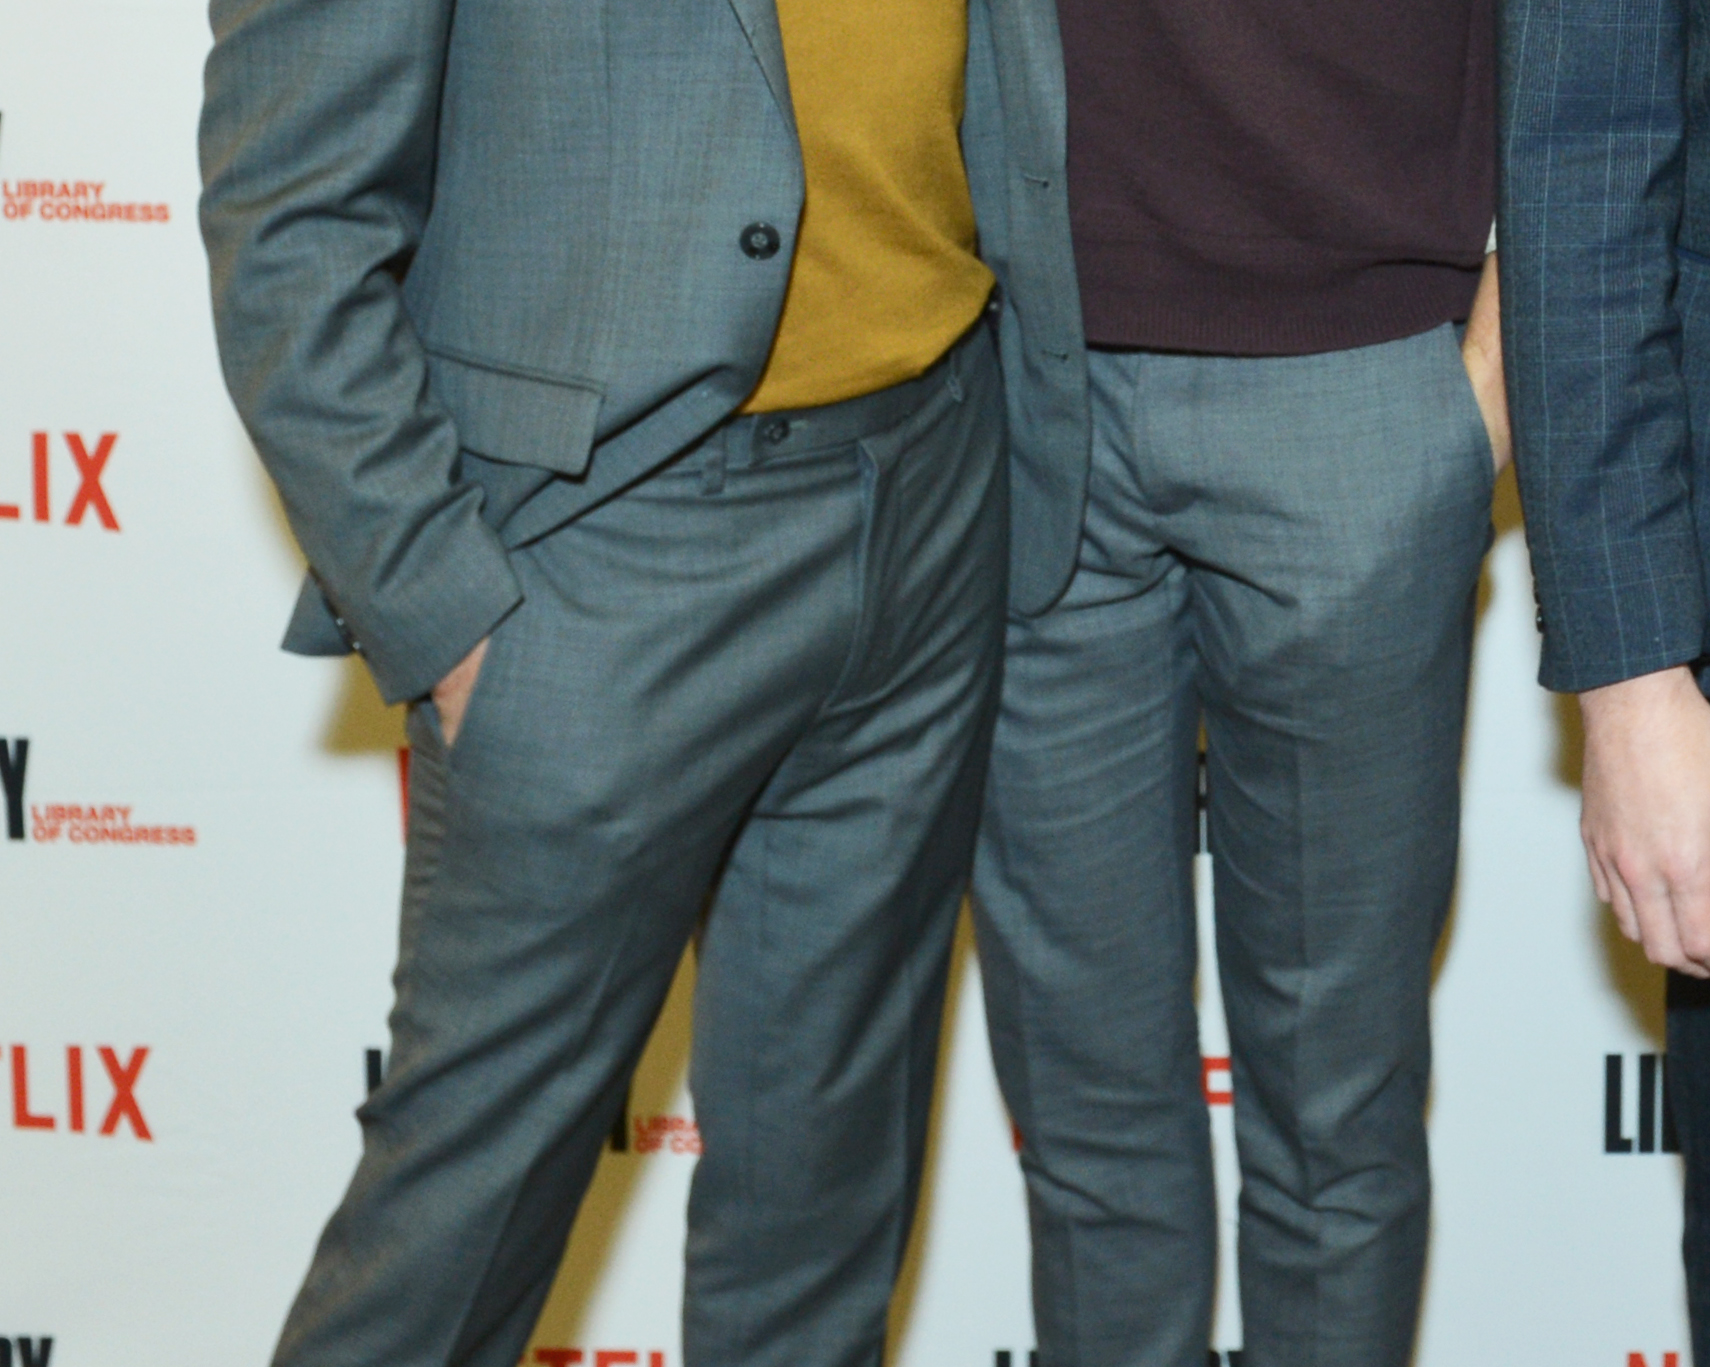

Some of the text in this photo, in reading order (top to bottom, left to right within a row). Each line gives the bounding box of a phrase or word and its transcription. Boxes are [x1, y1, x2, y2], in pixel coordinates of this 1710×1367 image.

[3, 181, 104, 200] LIBRARY
[4, 202, 170, 223] OF CONGRESS
[32, 805, 131, 824] LIBRARY
[33, 825, 196, 845] OF CONGRESS
